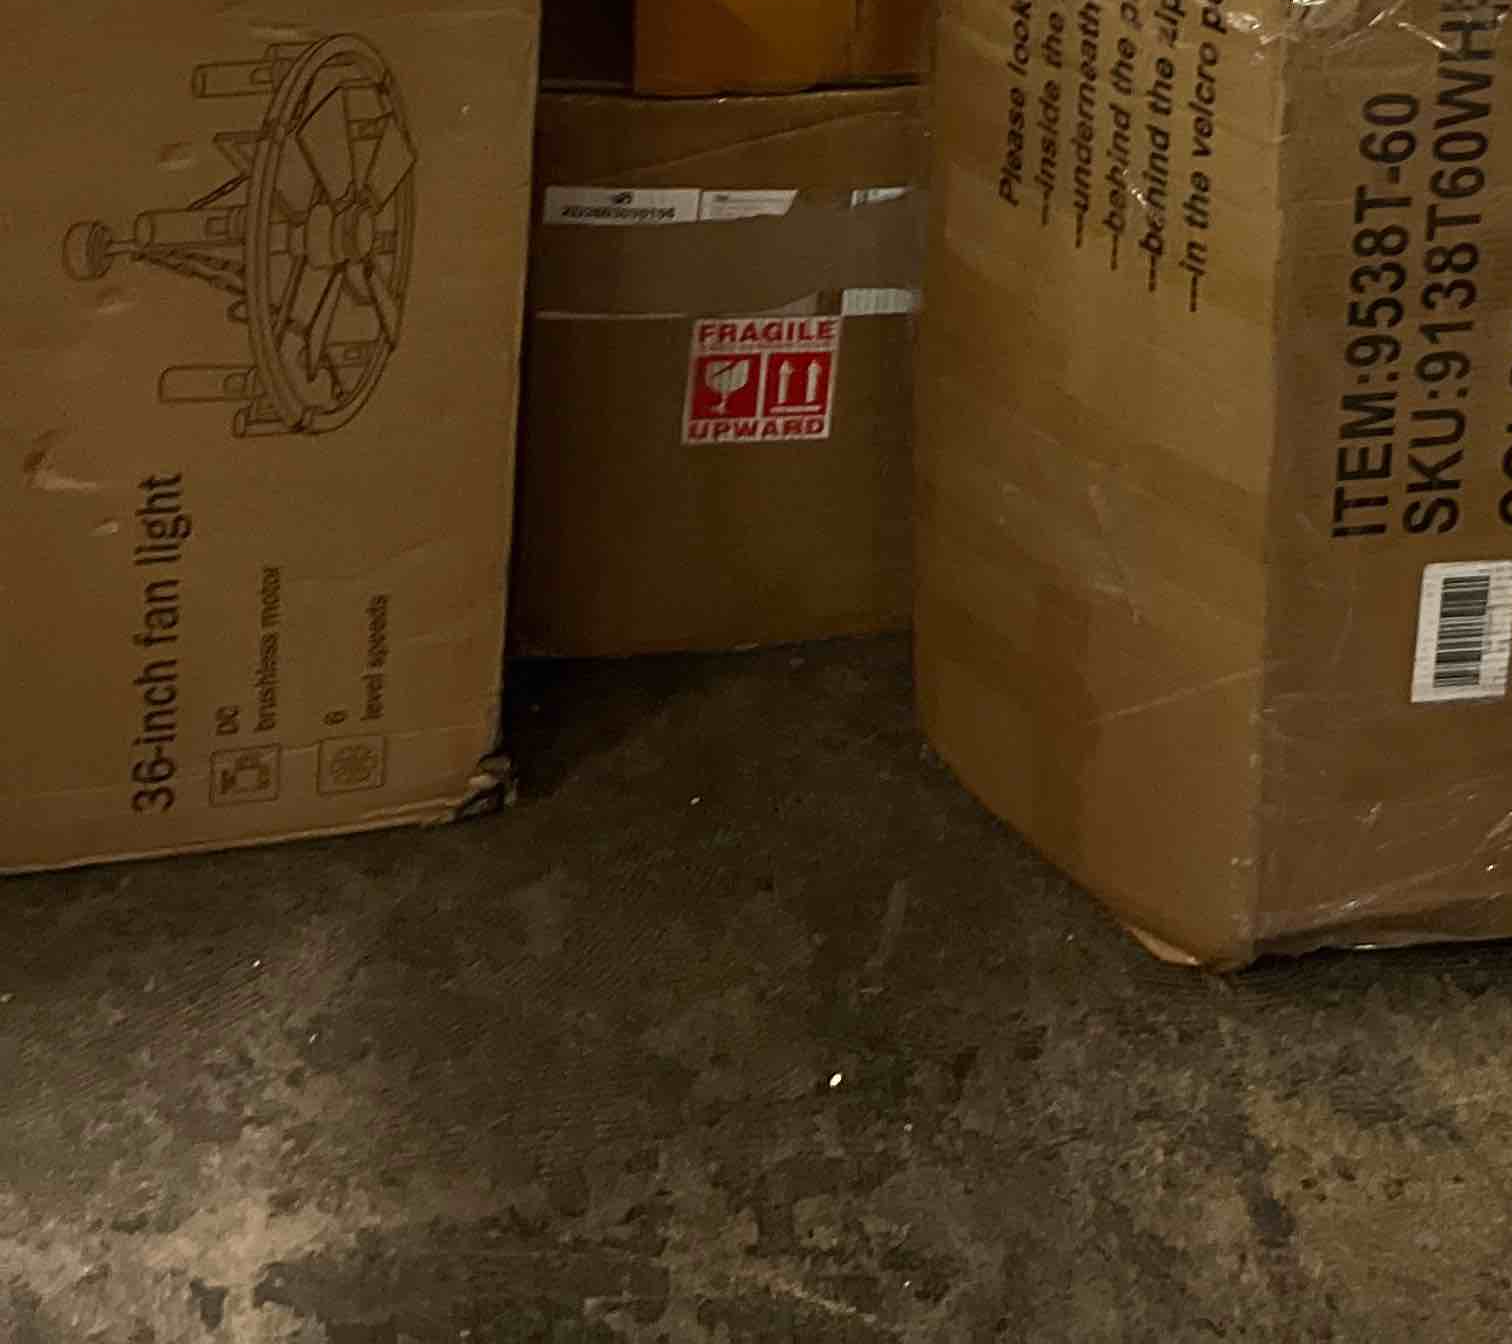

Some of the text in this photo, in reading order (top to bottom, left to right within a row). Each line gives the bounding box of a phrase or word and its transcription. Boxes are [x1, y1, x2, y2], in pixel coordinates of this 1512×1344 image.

[1040, 12, 1067, 69] the
[1110, 36, 1137, 97] the
[1149, 56, 1177, 117] the
[1188, 41, 1219, 159] velcro
[998, 88, 1026, 207] Please
[1184, 170, 1212, 230] the
[698, 319, 837, 343] FRAGILE
[1331, 93, 1420, 539] ITEM:9538T-60
[688, 418, 824, 440] UPWARD
[131, 472, 192, 812] 36-inch fan light
[253, 566, 281, 733] brushless motor
[360, 593, 390, 721] level speeds
